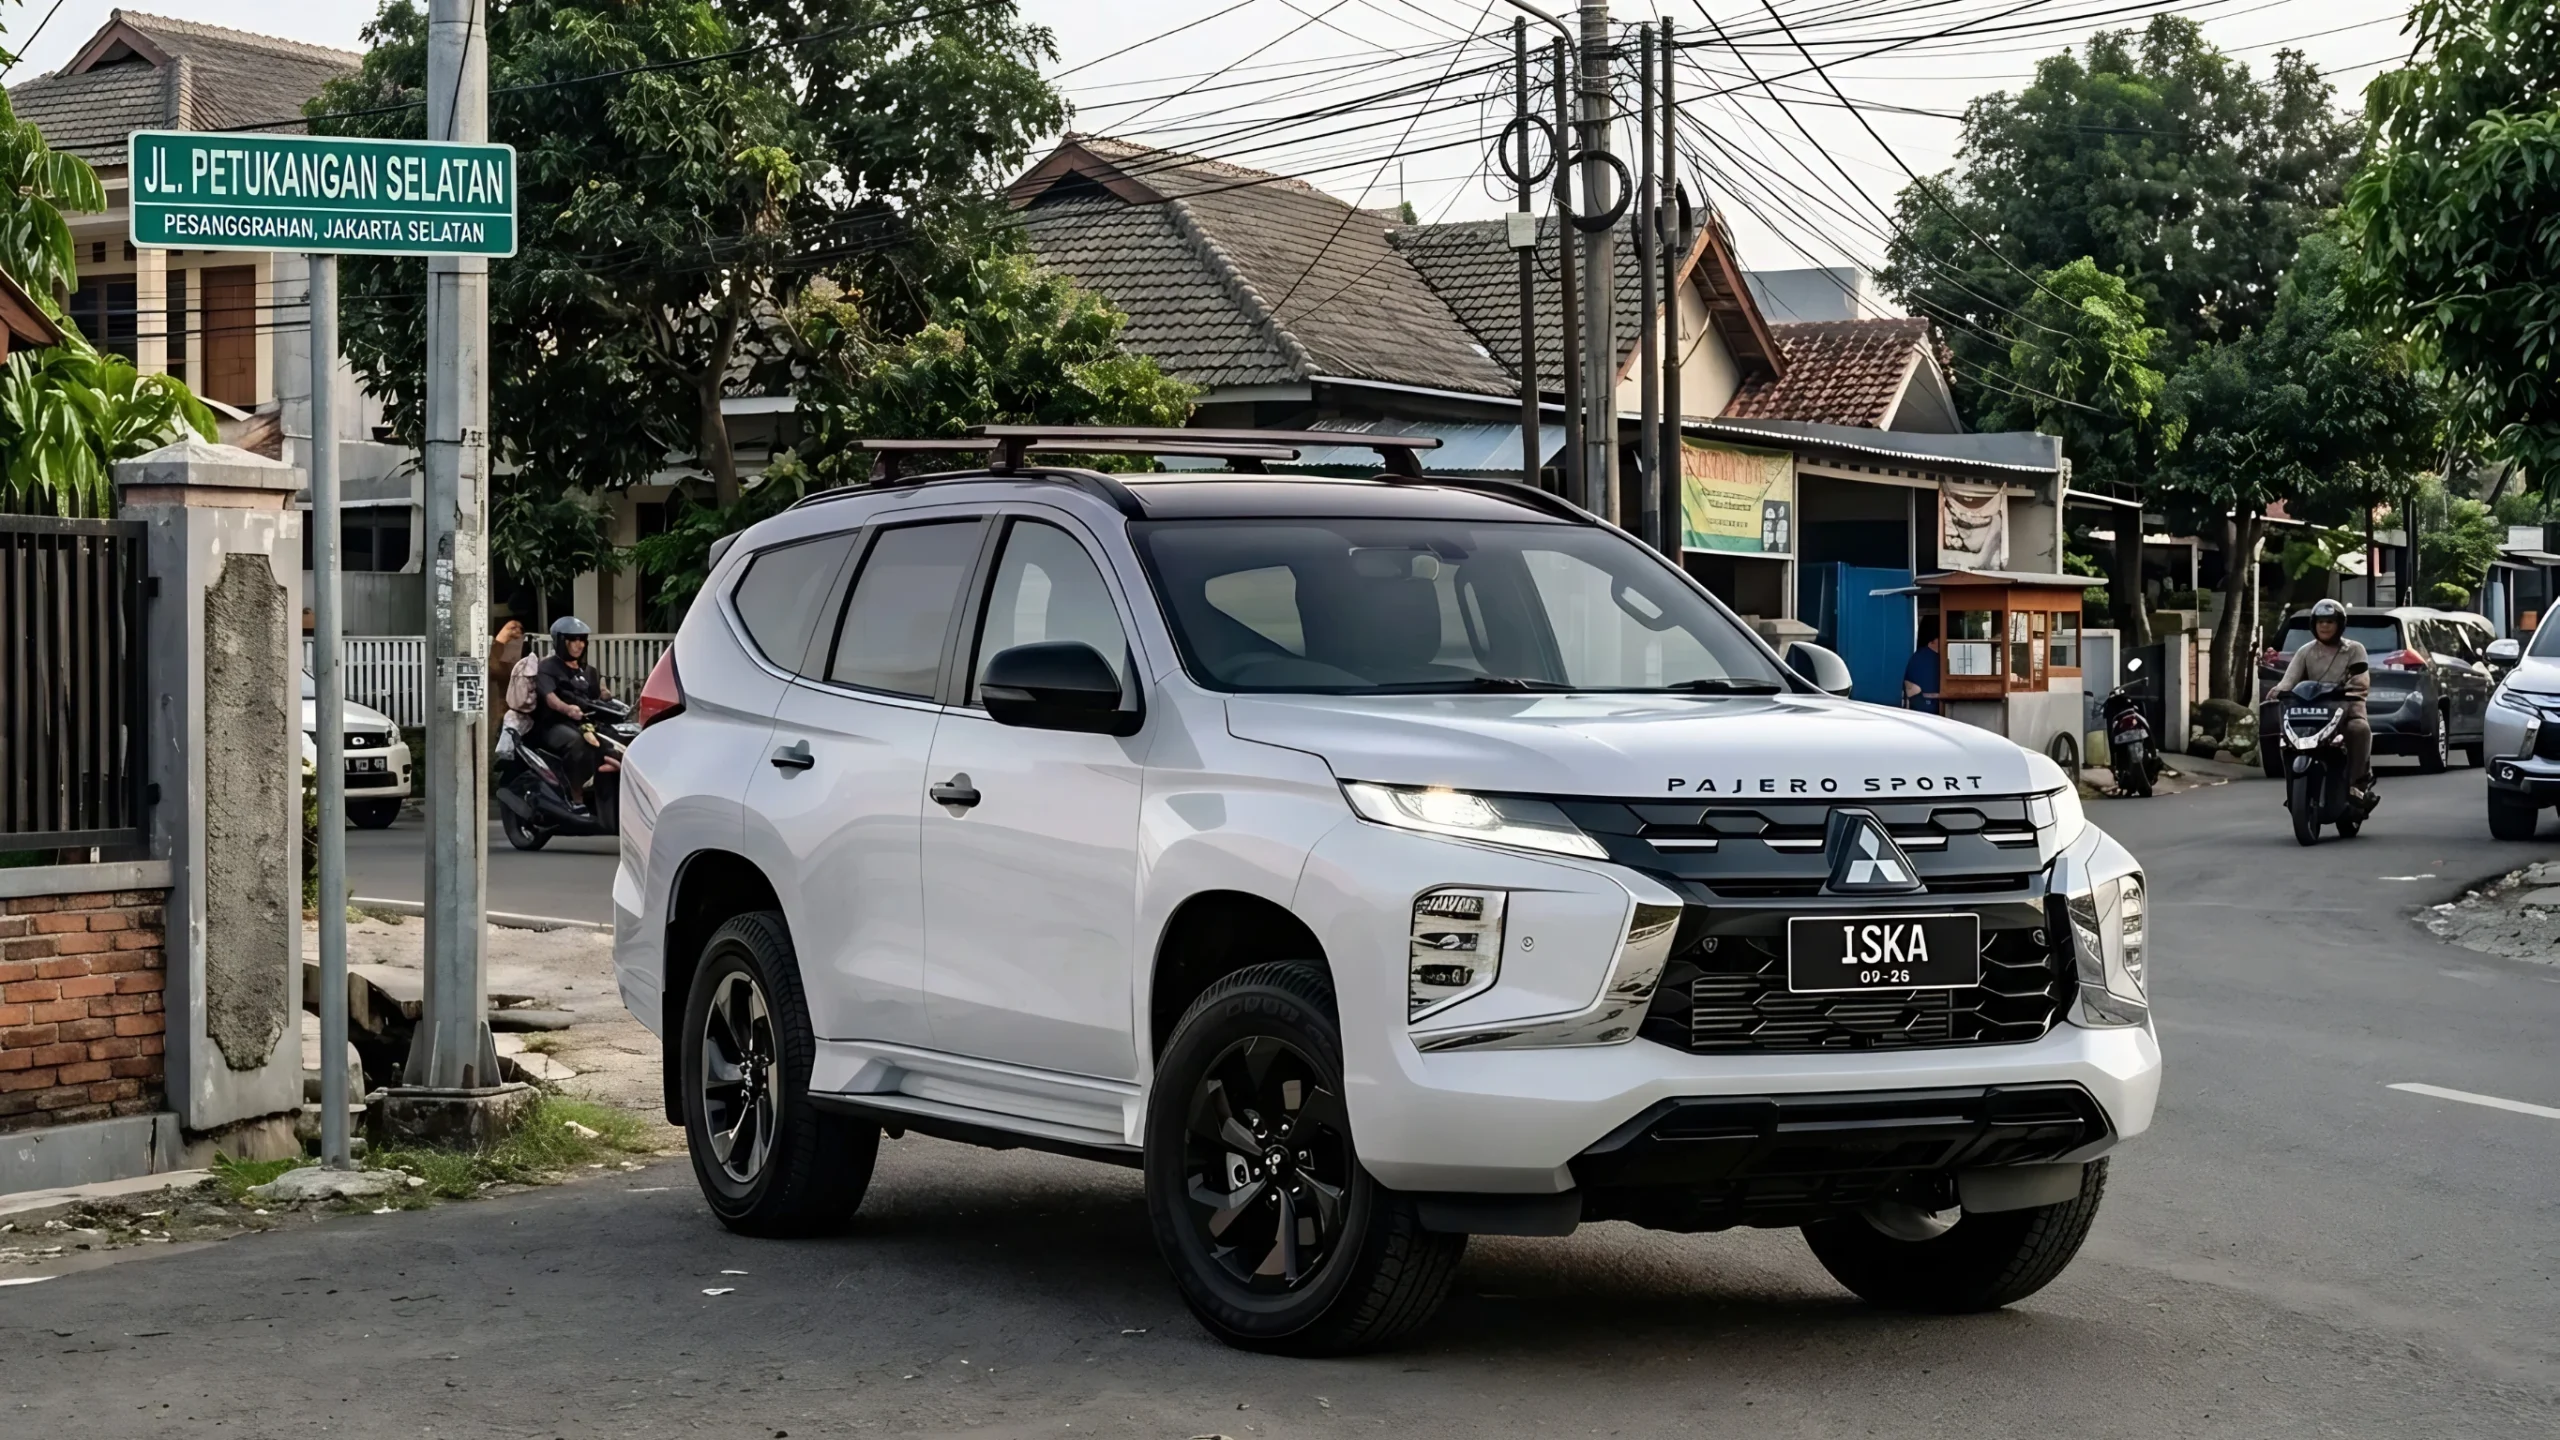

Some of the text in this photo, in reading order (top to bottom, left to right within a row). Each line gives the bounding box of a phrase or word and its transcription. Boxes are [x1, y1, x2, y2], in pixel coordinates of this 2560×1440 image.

[144, 145, 503, 204] JL. PETUKANGAN SELATAN
[164, 213, 484, 243] PESANGGRAHAN, JAKARTA SELATAN
[1667, 776, 1983, 794] PAJERO SPORT
[1841, 923, 1929, 964] ISKA
